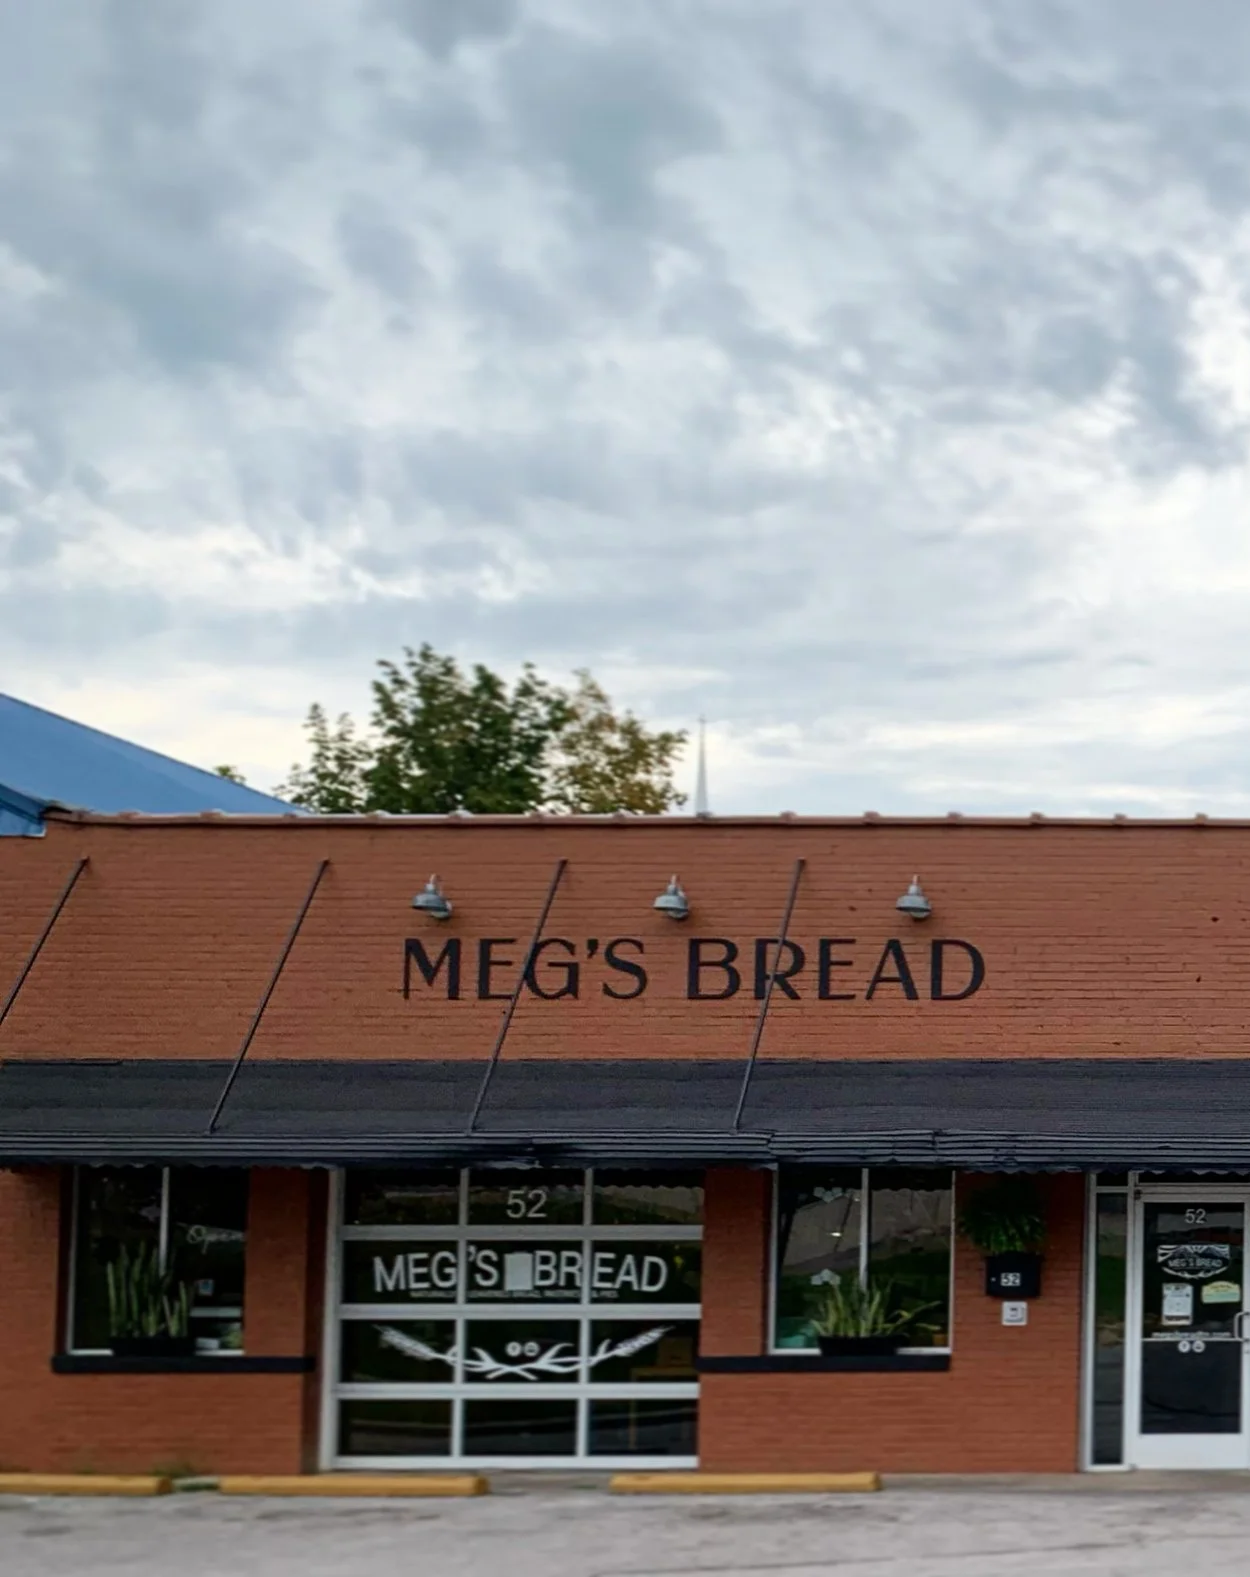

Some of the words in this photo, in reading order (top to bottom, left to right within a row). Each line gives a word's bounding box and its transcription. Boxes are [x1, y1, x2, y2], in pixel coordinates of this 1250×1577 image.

[402, 938, 649, 1000] MEG'S
[687, 938, 986, 1001] BREAD
[506, 1190, 547, 1218] 52
[1185, 1208, 1207, 1224] 52
[373, 1245, 498, 1292] MEG'S
[534, 1250, 668, 1292] BREAD
[1001, 1273, 1020, 1287] 52
